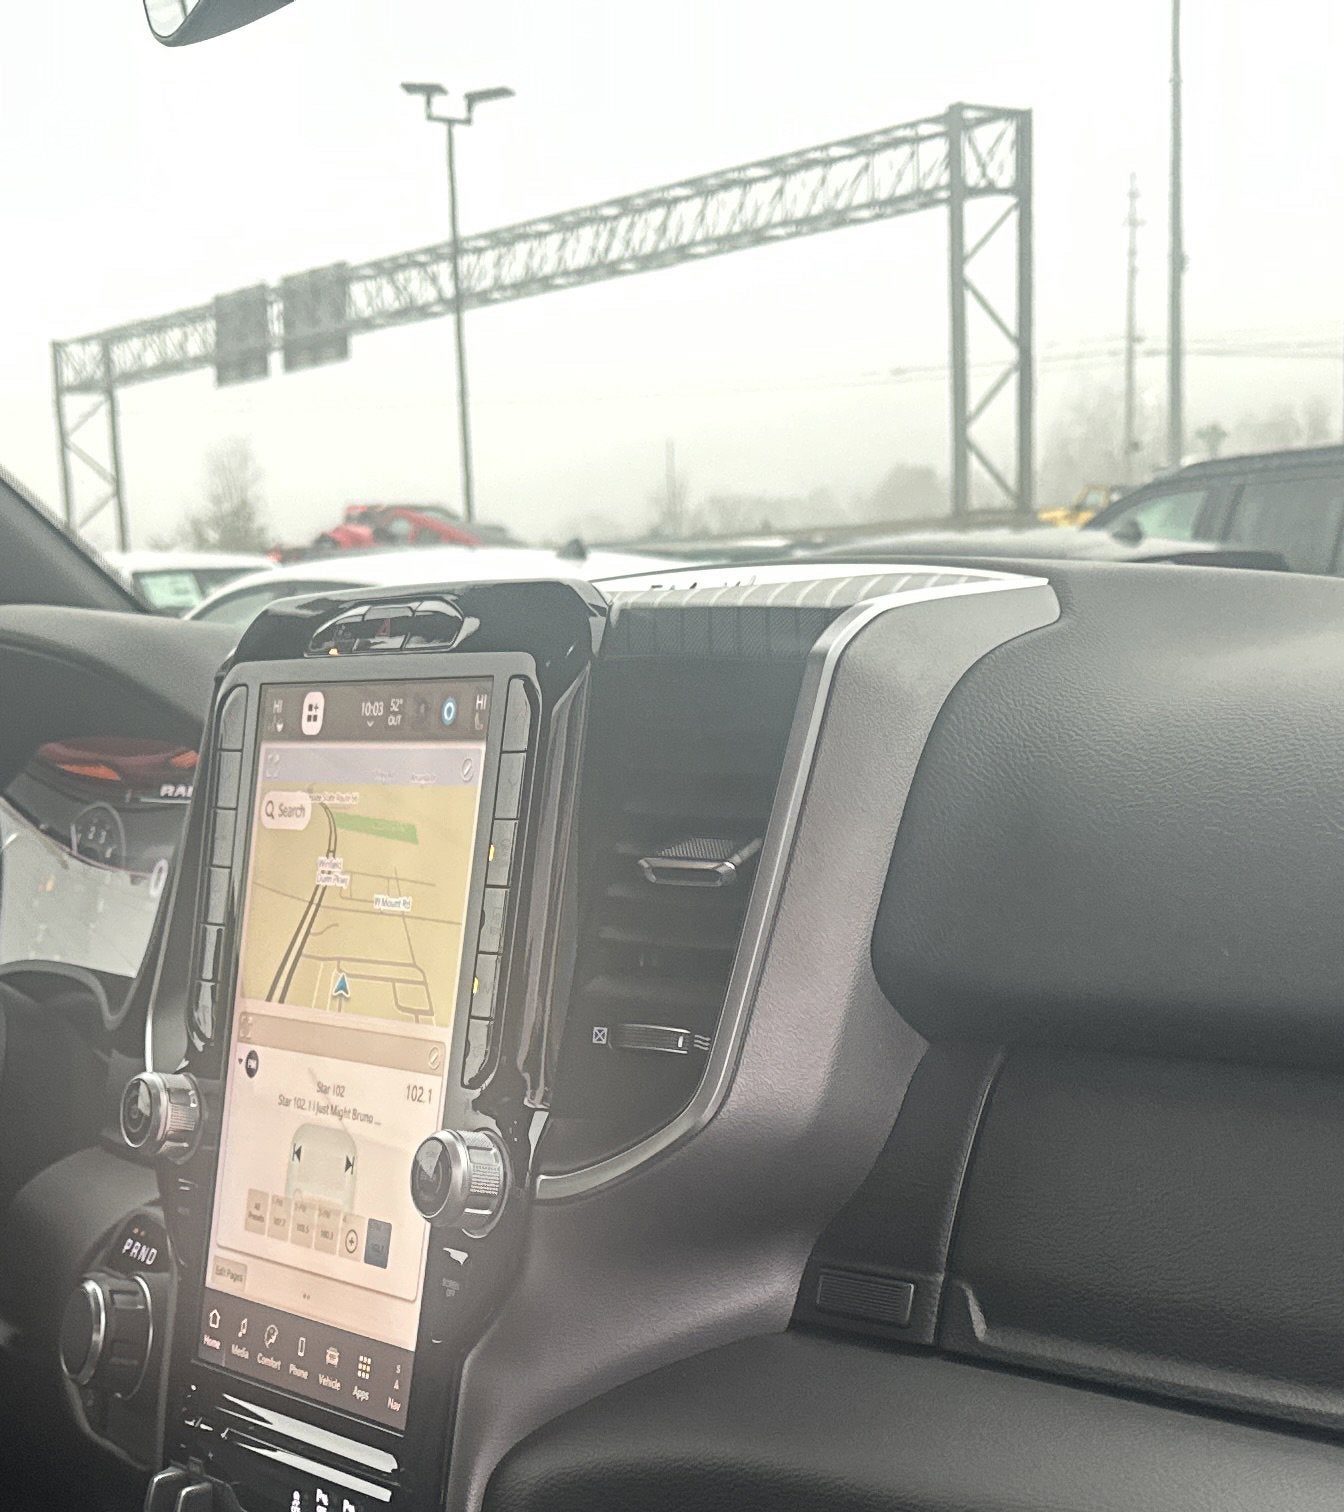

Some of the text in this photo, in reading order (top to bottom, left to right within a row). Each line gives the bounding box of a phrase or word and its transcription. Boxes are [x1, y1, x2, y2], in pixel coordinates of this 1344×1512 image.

[361, 701, 384, 716] 10:03
[476, 695, 487, 709] HI
[388, 715, 402, 726] OUT
[278, 802, 305, 818] Search
[316, 1081, 345, 1097] Star 102
[406, 1084, 433, 1104] 102.1
[278, 1094, 291, 1107] Star
[203, 1334, 221, 1350] Home
[231, 1344, 249, 1359] Media
[257, 1352, 281, 1371] Comfort
[289, 1363, 308, 1379] Phone
[318, 1373, 341, 1391] Vehicle
[352, 1385, 369, 1402] Apps
[388, 1396, 401, 1412] Nav
